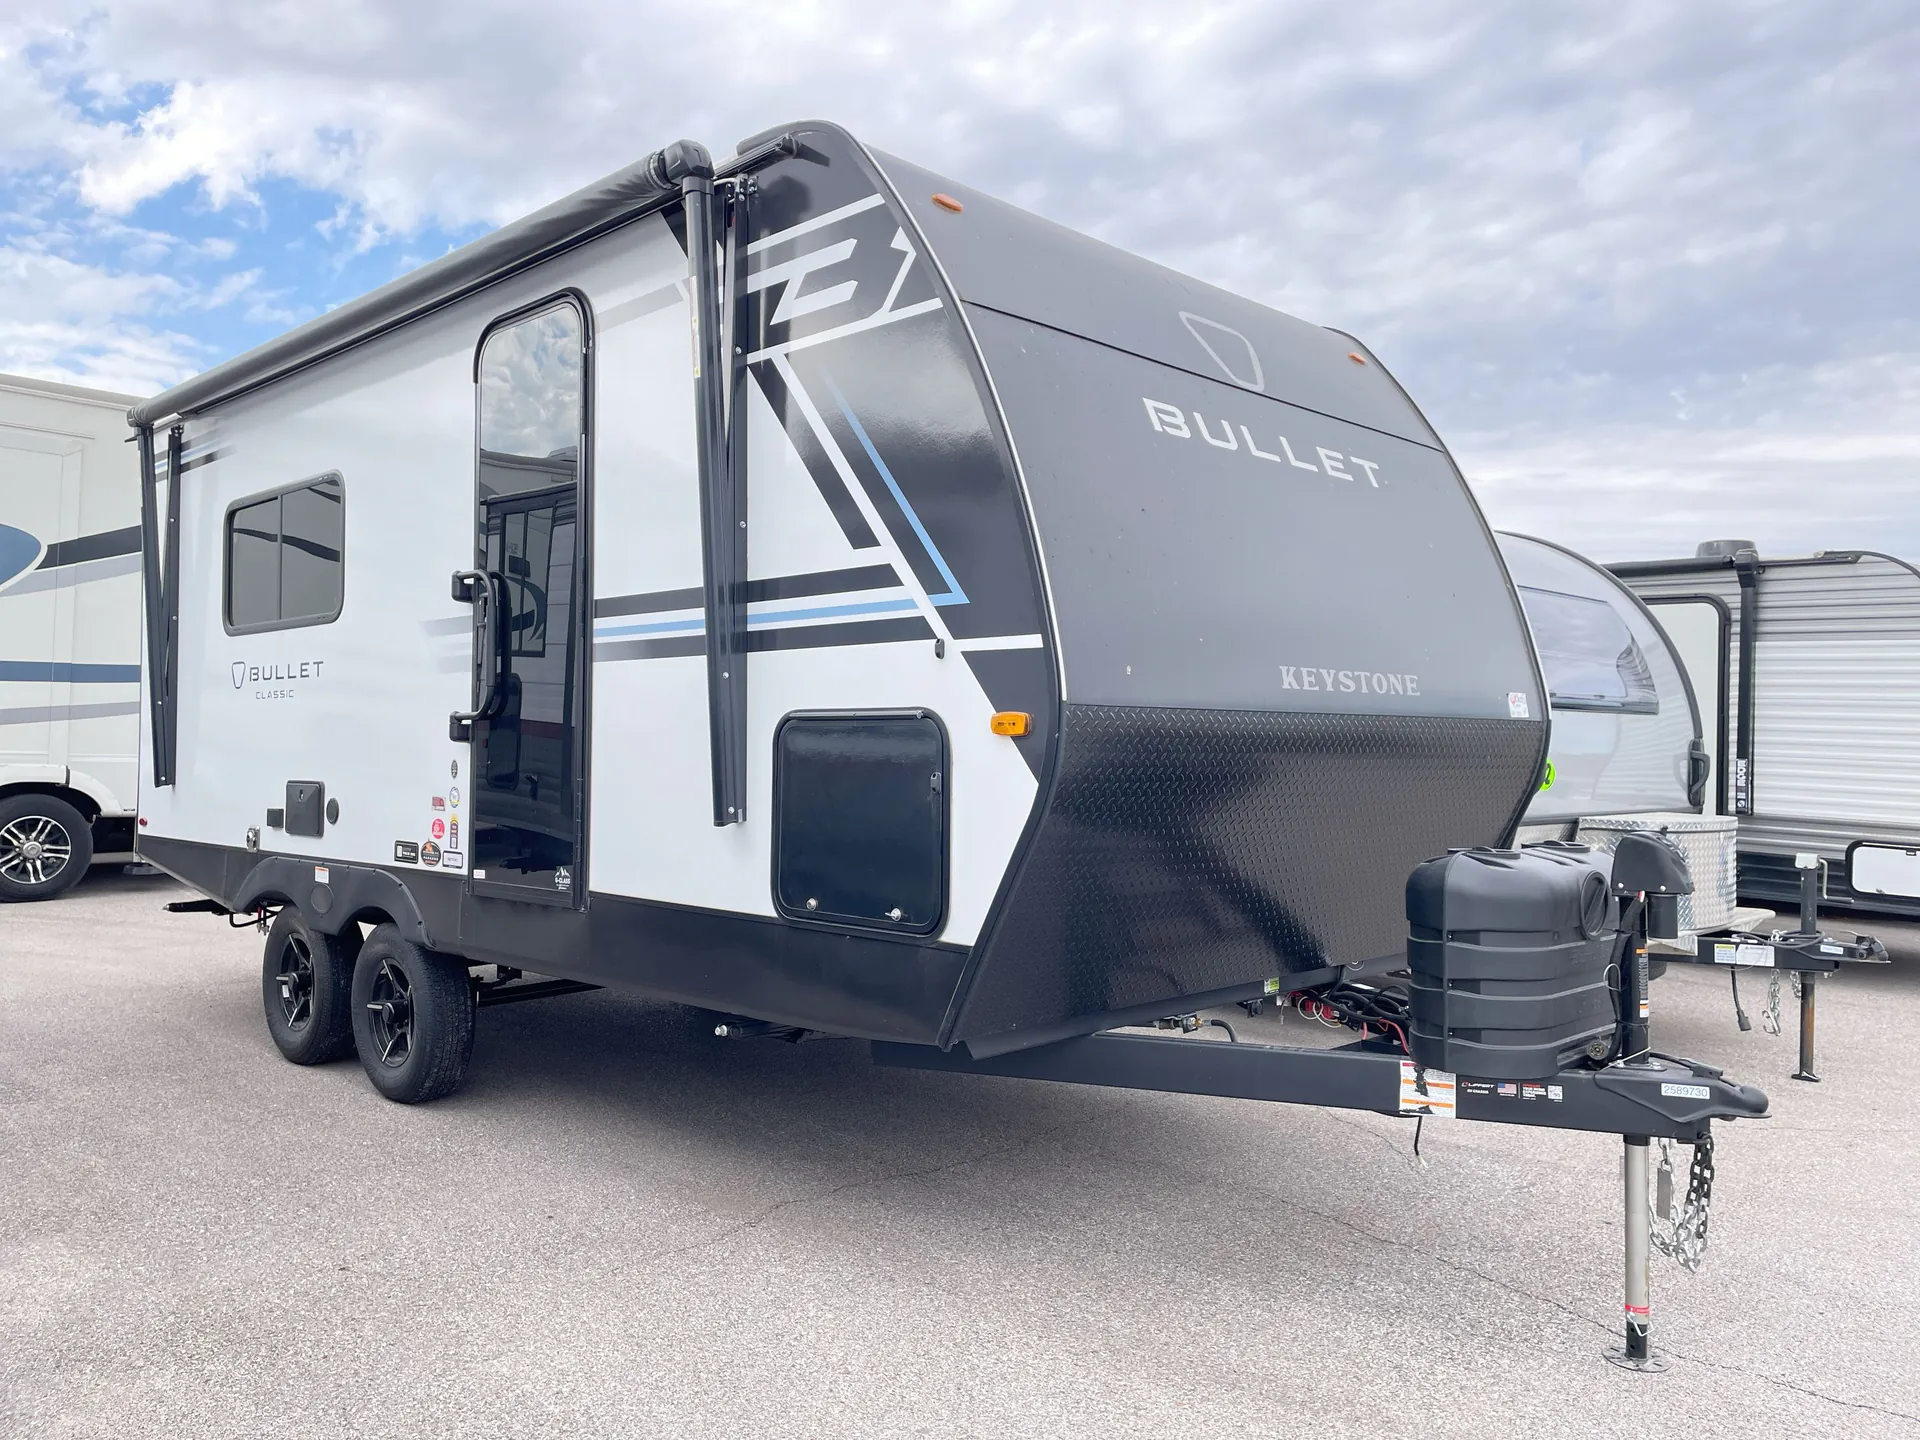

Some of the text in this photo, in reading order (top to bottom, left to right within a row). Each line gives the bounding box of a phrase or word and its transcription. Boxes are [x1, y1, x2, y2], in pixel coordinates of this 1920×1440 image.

[1142, 397, 1379, 488] BULLET
[249, 661, 324, 682] BULLET
[1279, 665, 1421, 696] KEYSTONE
[255, 689, 295, 700] CLASSIC
[1663, 1084, 1709, 1098] 2589730
